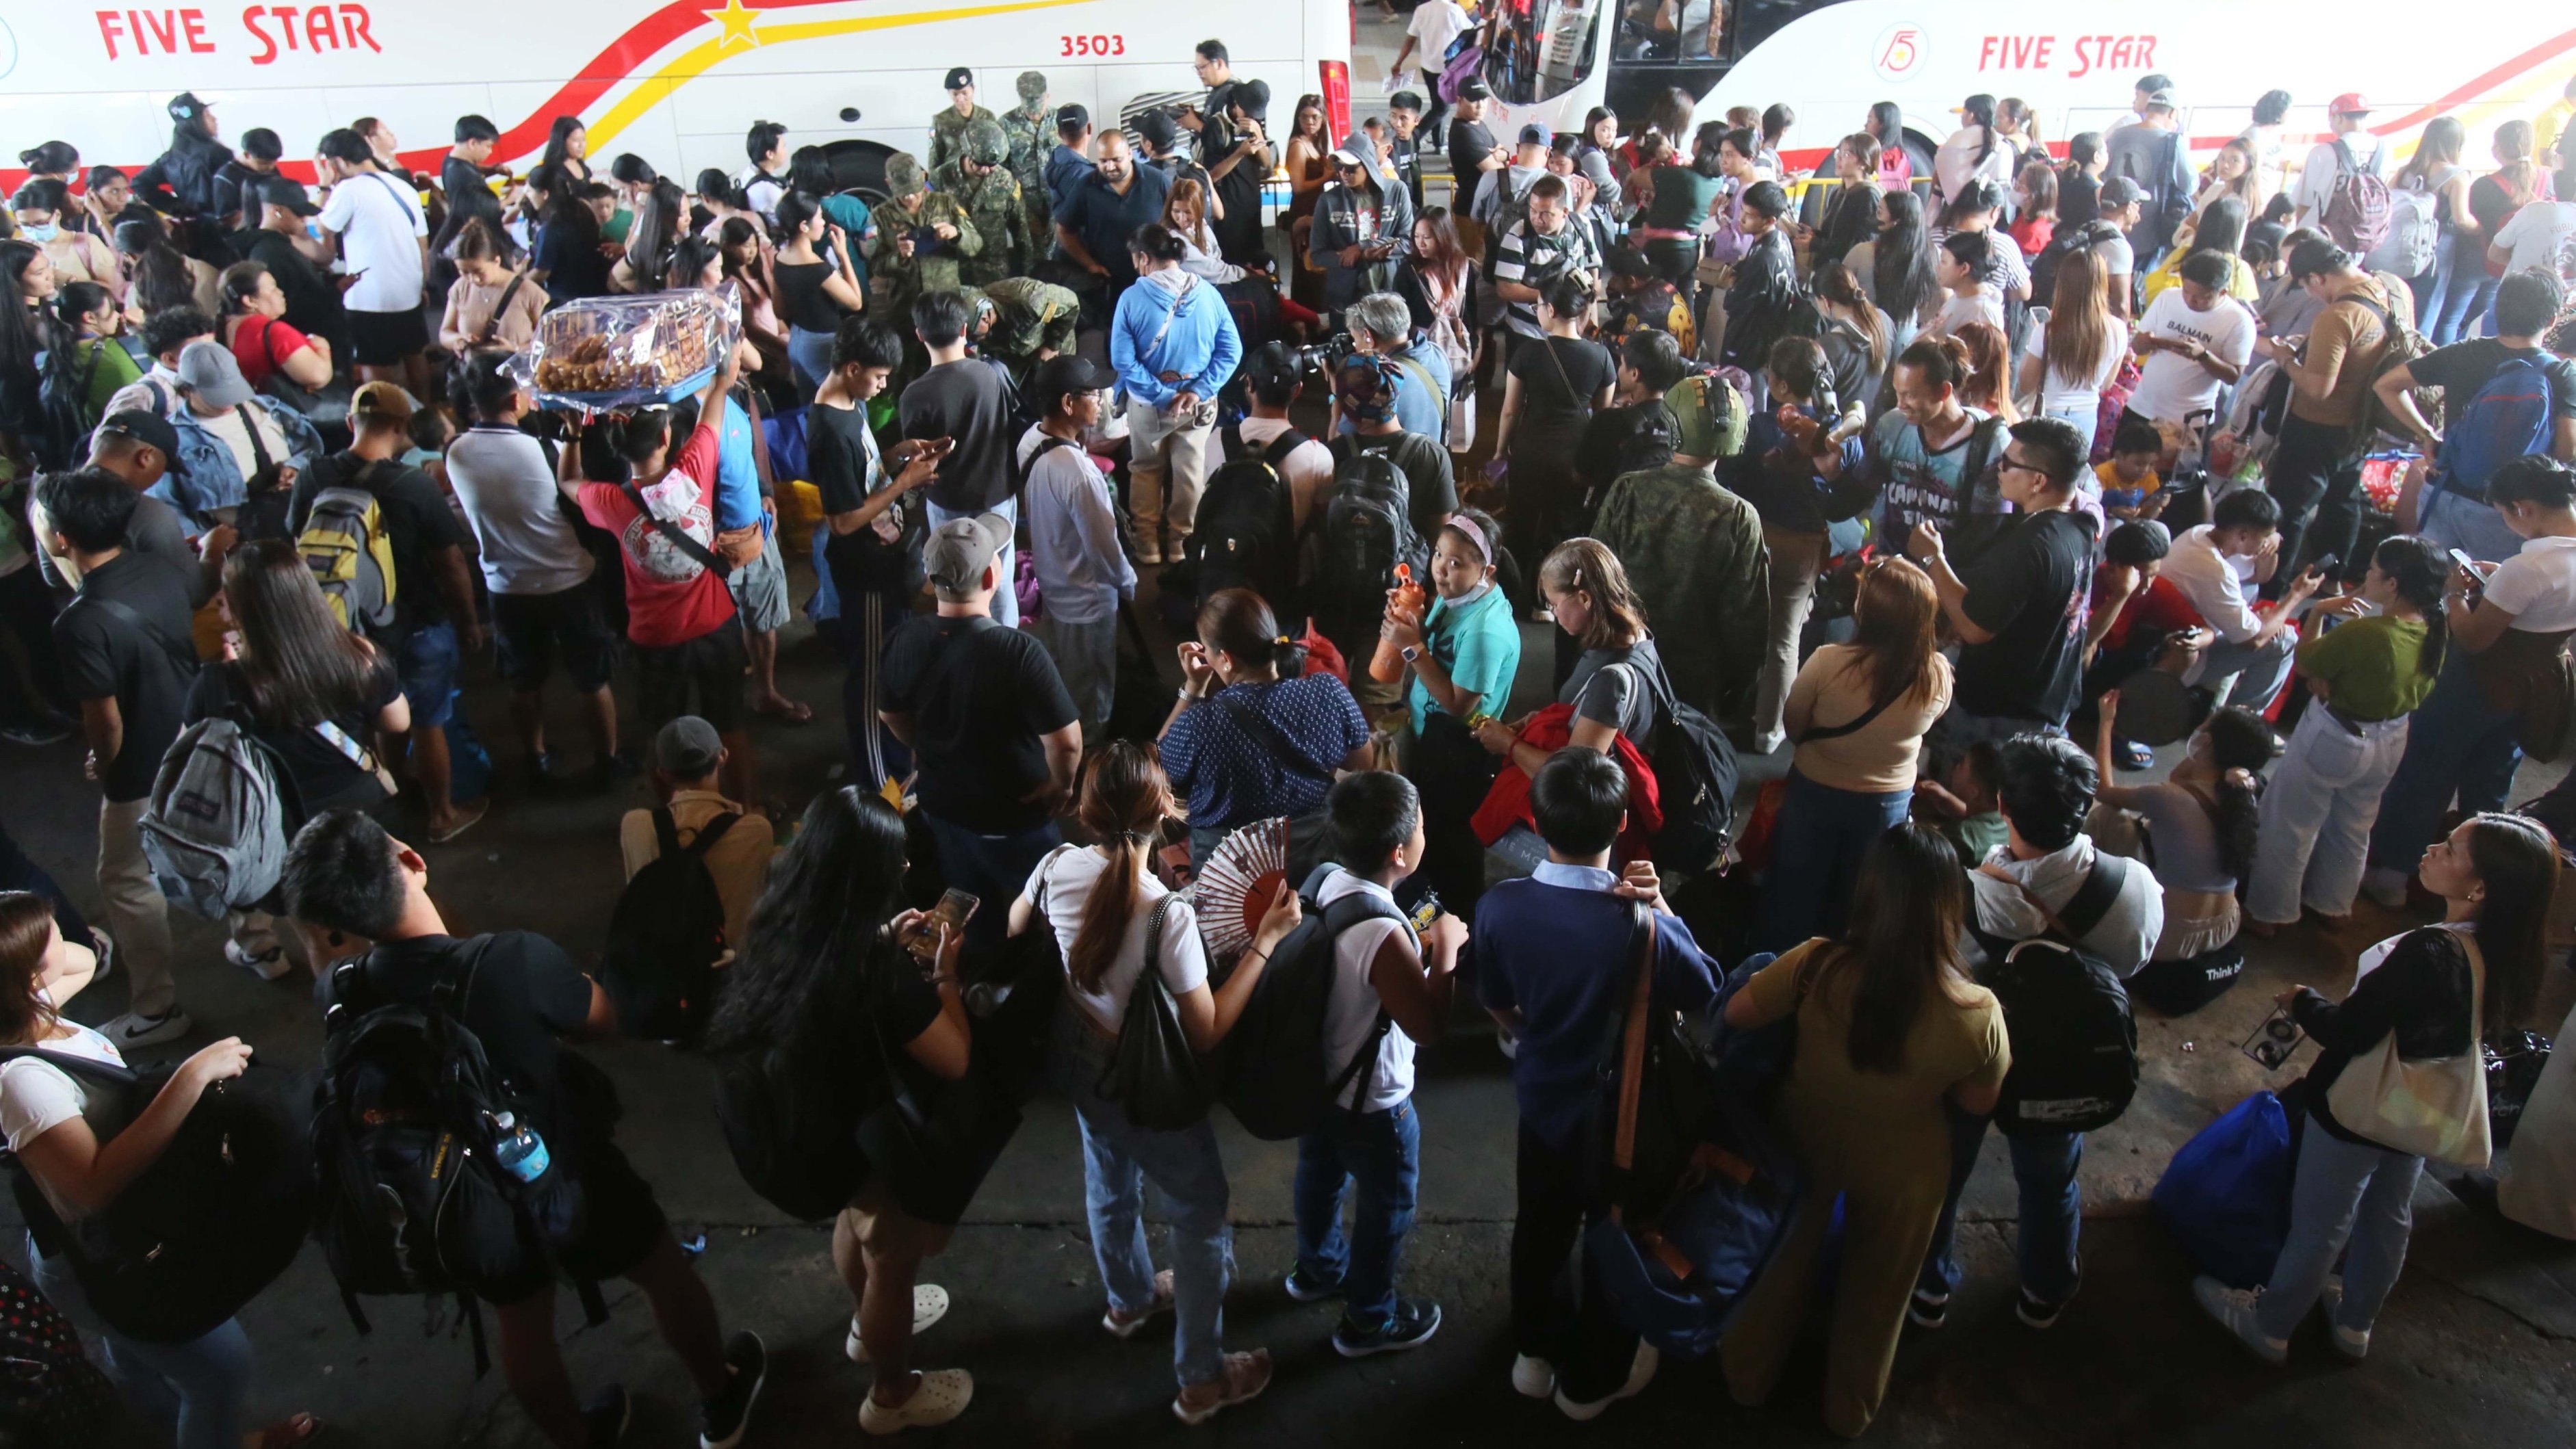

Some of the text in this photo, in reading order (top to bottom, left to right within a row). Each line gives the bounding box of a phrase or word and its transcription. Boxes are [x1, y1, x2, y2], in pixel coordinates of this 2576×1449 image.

[95, 3, 382, 64] FIVE STAR
[1061, 34, 1124, 56] 3503
[1978, 36, 2157, 78] FIVE STAR
[2549, 222, 2573, 235] FUBU
[2166, 320, 2213, 343] BALMAIN
[2206, 965, 2233, 981] Think
